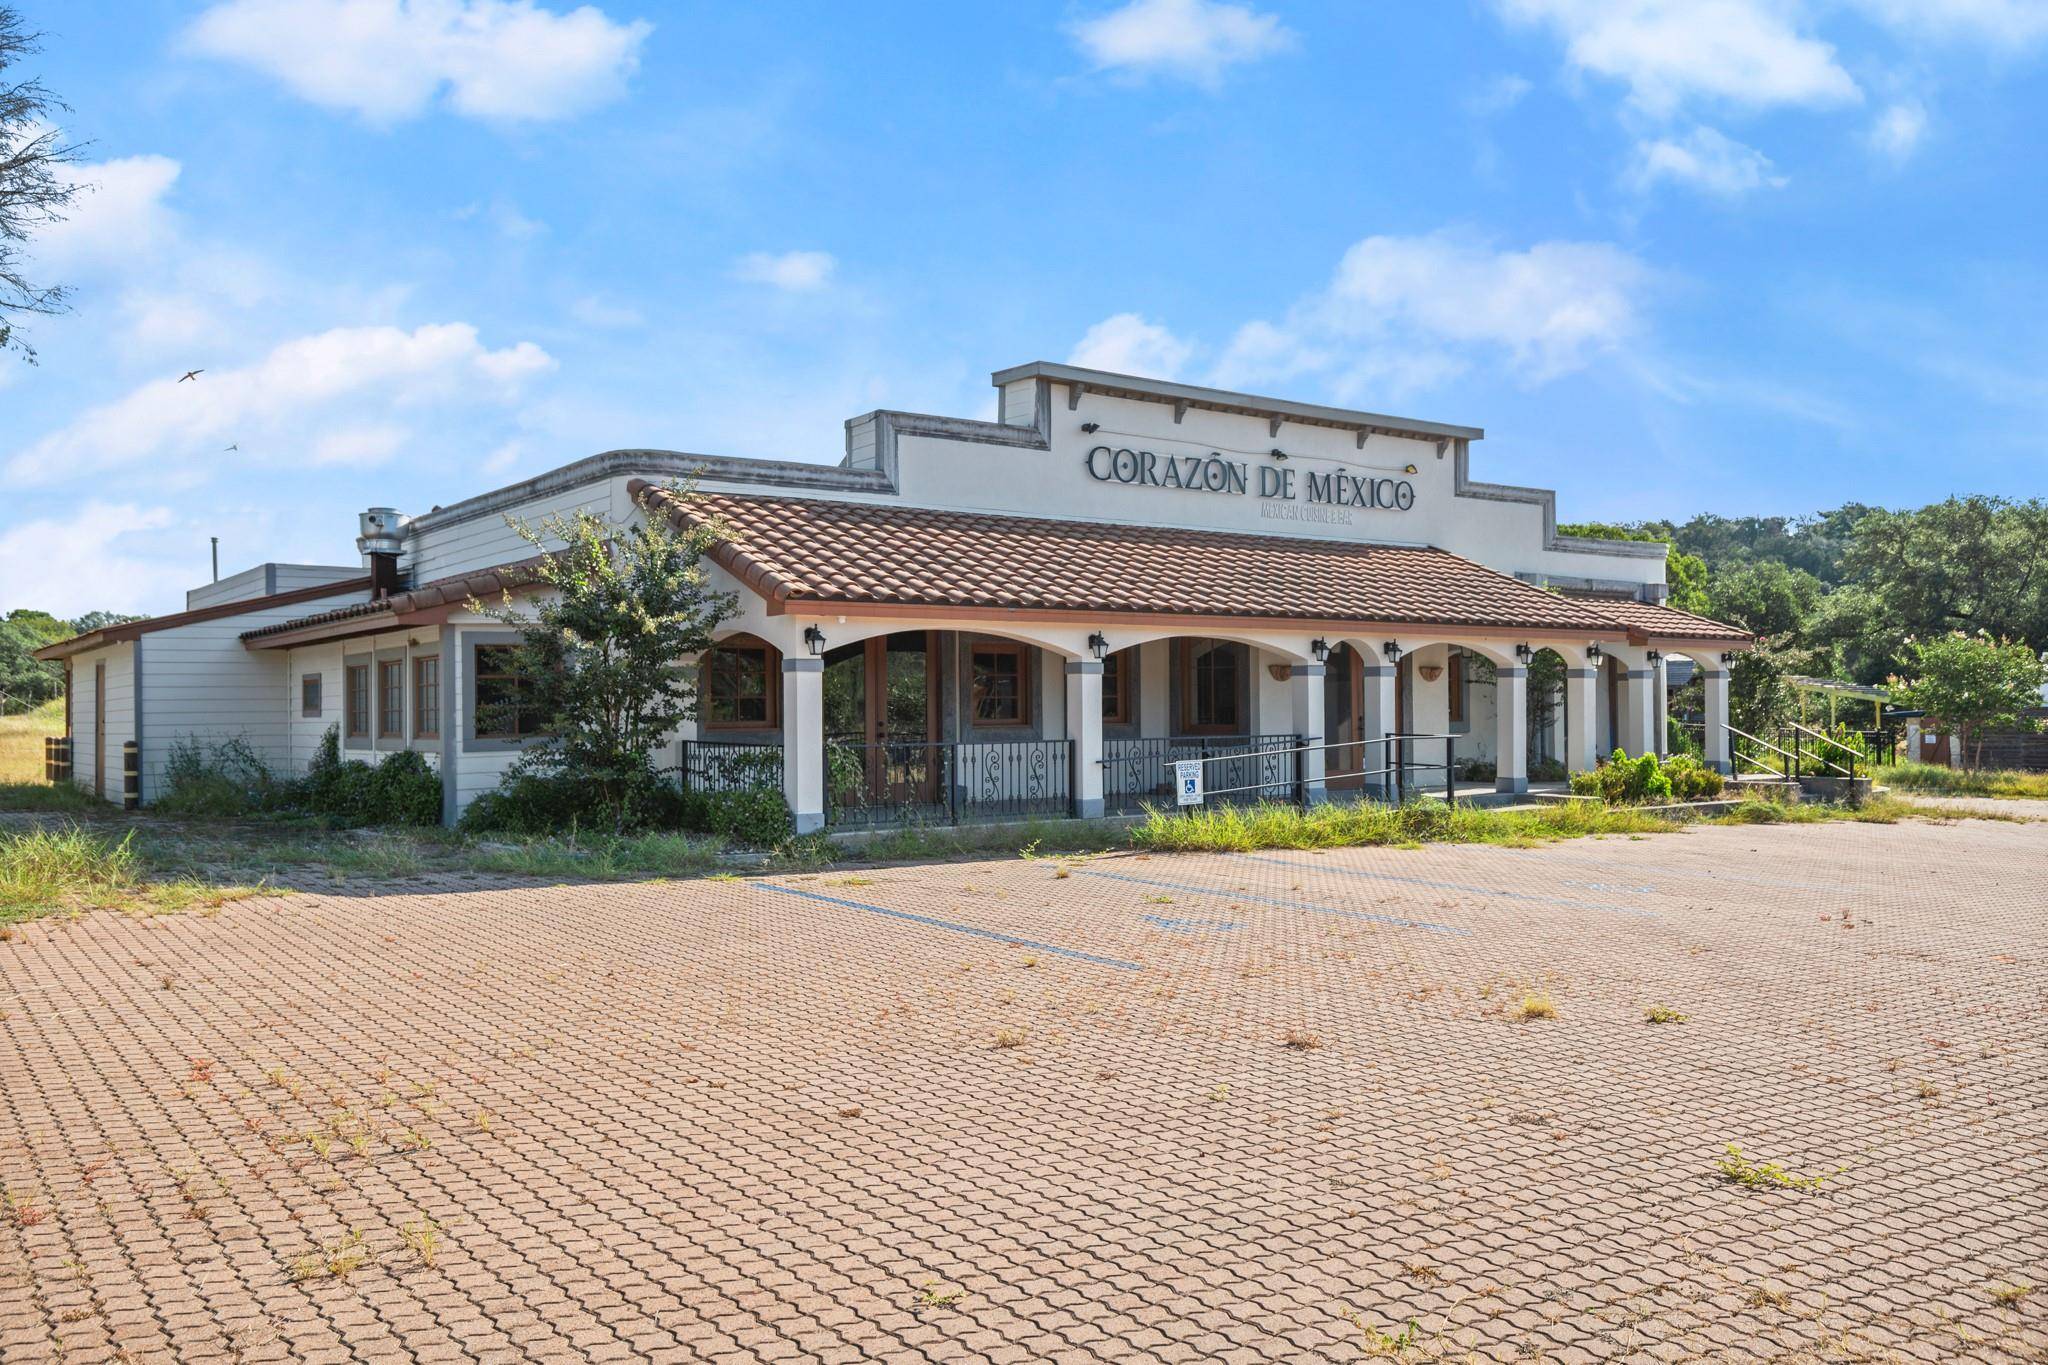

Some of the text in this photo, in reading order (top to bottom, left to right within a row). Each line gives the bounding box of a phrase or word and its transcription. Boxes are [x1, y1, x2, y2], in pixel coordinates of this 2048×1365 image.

[1086, 446, 1416, 511] CORAZÓN DE MÉXICO
[1260, 502, 1299, 520] MEXICAN
[1178, 762, 1200, 771] RESERVED
[1180, 770, 1199, 778] PARKING
